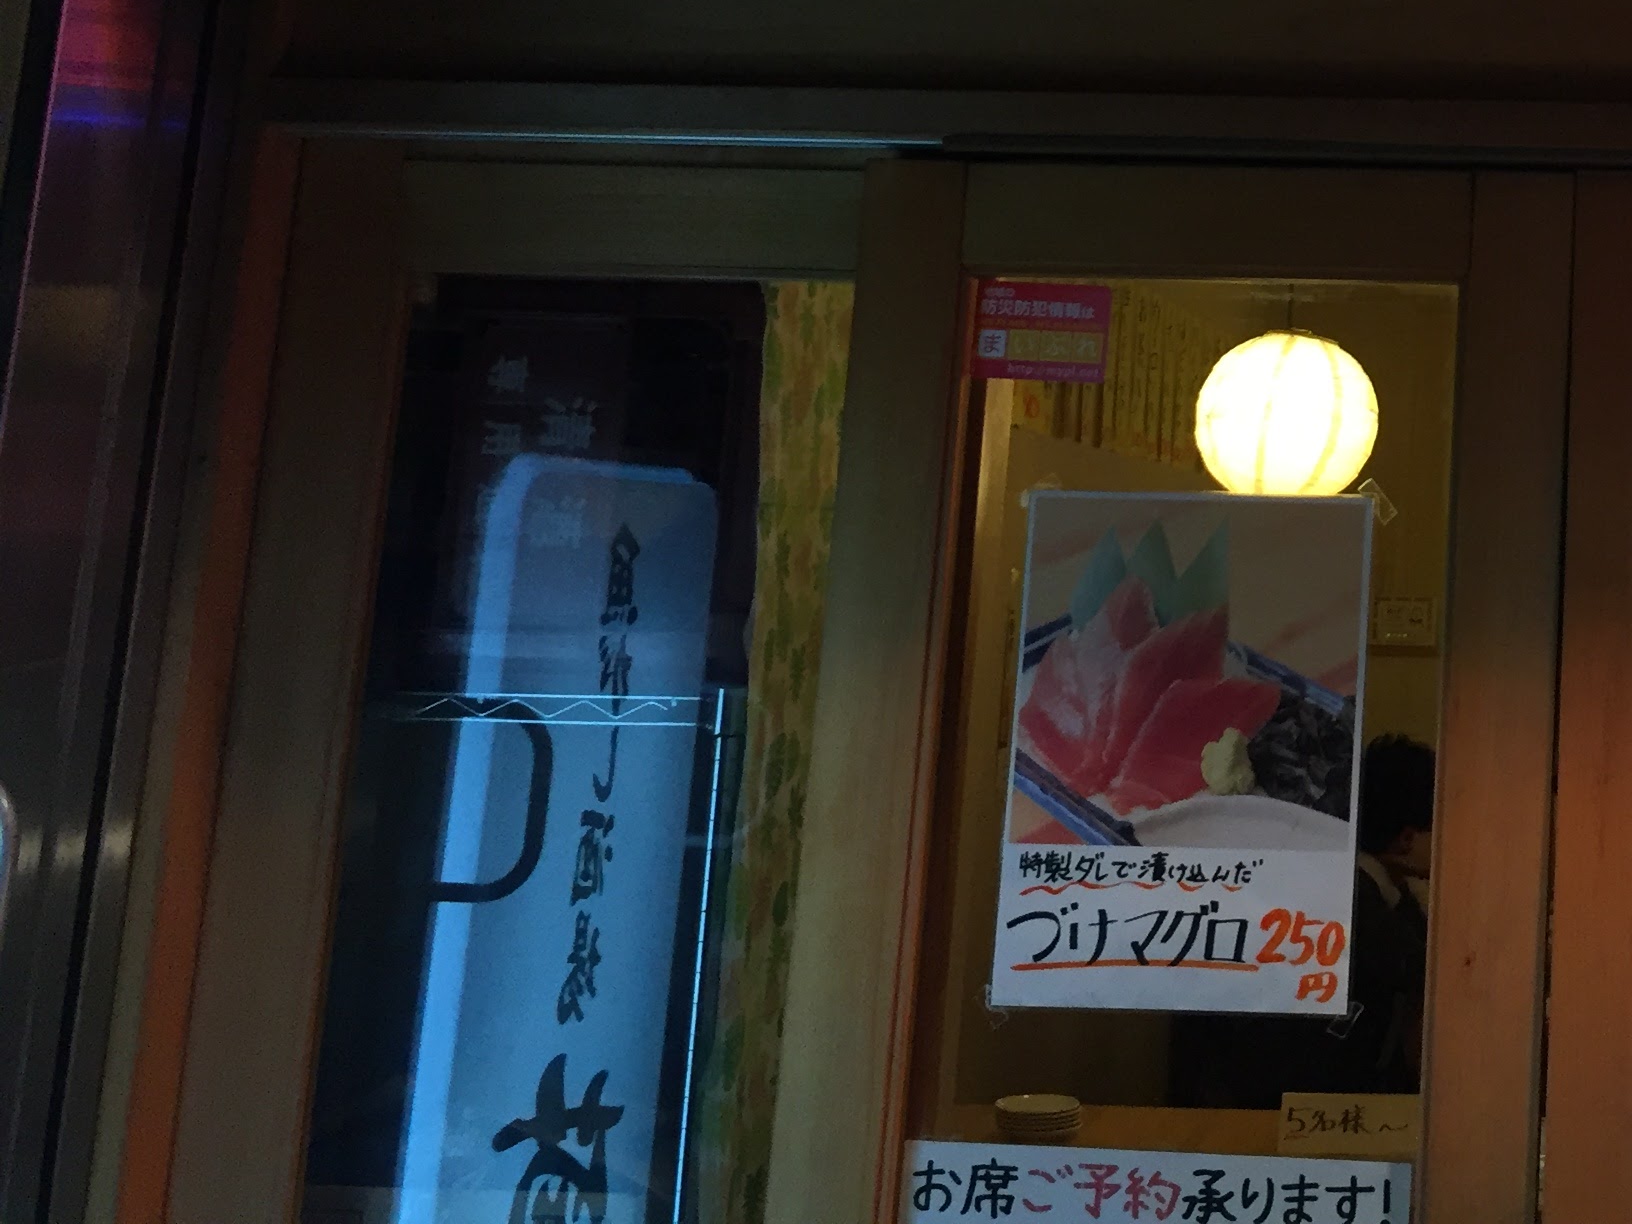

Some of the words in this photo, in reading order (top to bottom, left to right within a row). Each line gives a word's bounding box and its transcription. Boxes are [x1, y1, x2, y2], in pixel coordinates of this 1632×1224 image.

[981, 299, 1095, 320] 防災防犯情報は
[1006, 900, 1250, 967] づけマグロ
